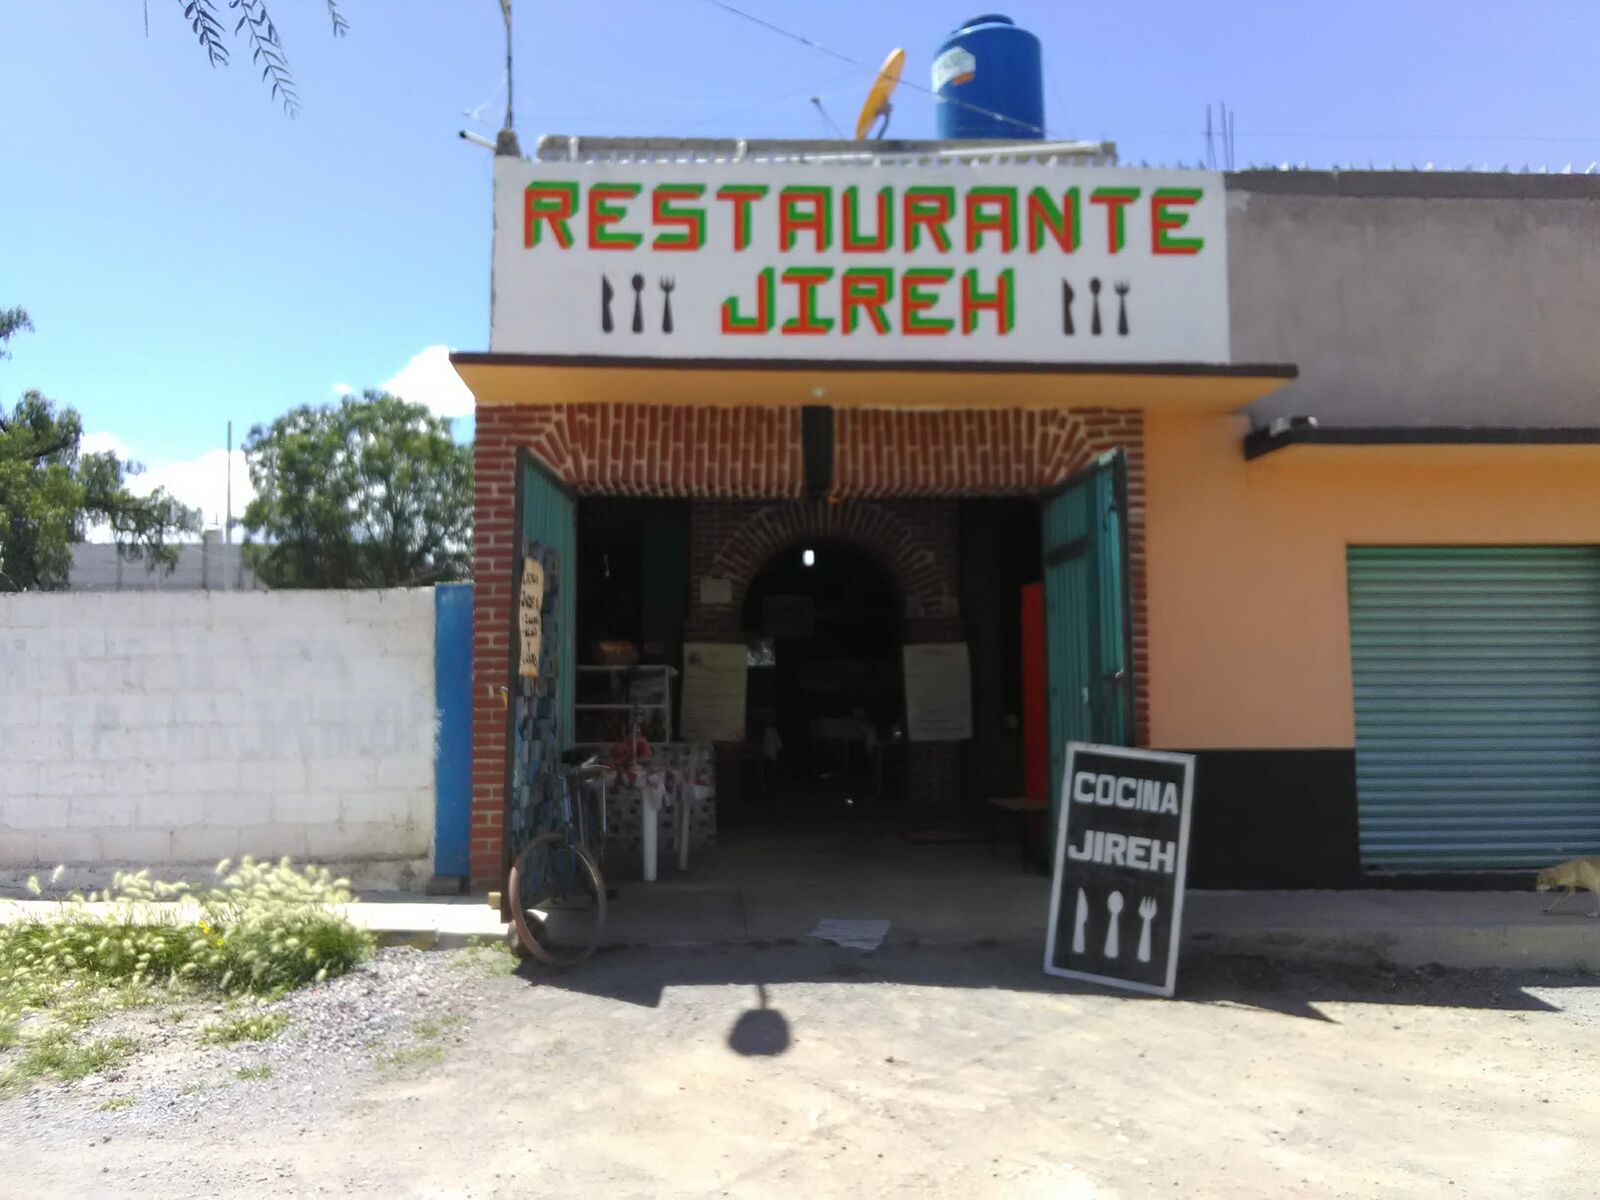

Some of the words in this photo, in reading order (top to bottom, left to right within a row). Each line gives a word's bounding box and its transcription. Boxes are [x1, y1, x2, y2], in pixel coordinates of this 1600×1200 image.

[523, 181, 1205, 255] RESTAURANTE
[721, 266, 1016, 336] JIREH
[1074, 772, 1179, 815] COCINA
[1068, 830, 1176, 873] JIREH
